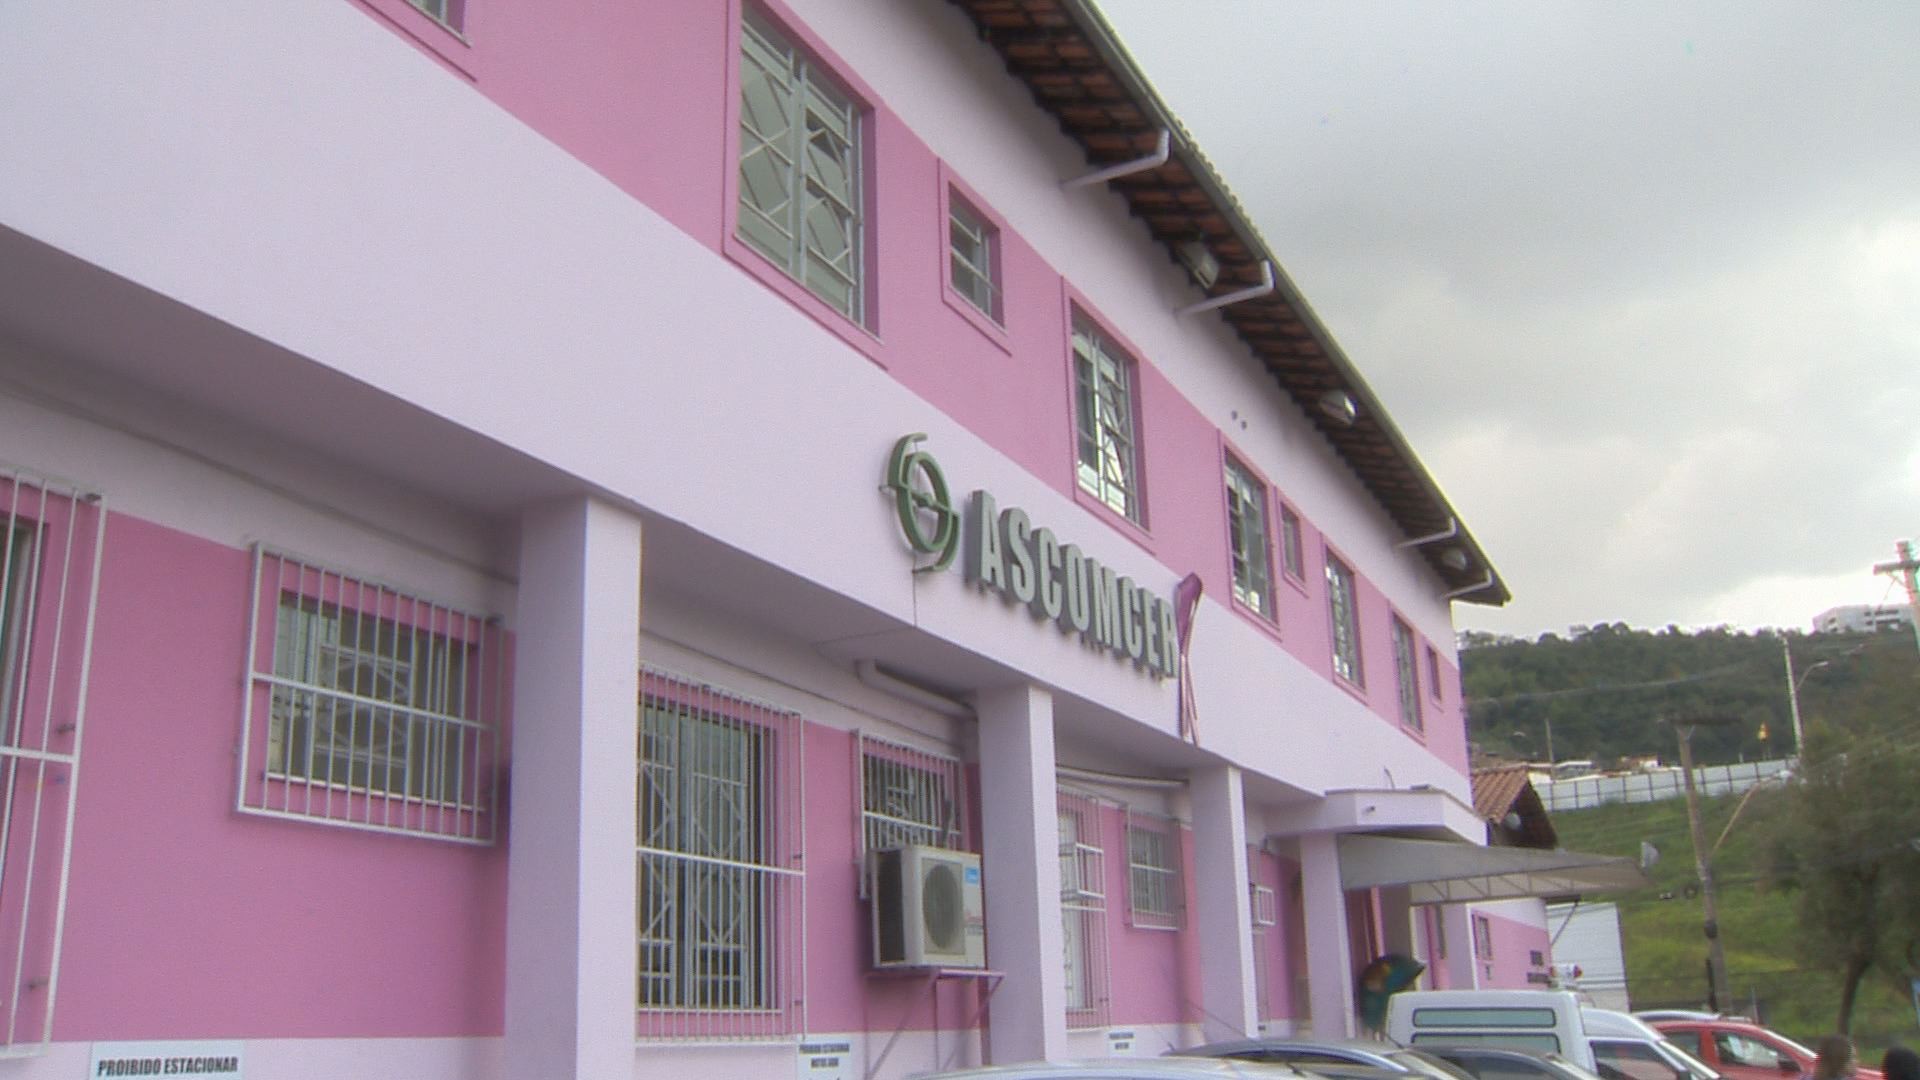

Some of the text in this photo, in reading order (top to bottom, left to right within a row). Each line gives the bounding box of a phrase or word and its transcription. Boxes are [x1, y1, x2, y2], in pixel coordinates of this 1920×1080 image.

[969, 490, 1179, 677] ASCOMCER
[97, 1056, 239, 1077] PROIBIDO ESTACIONAR
